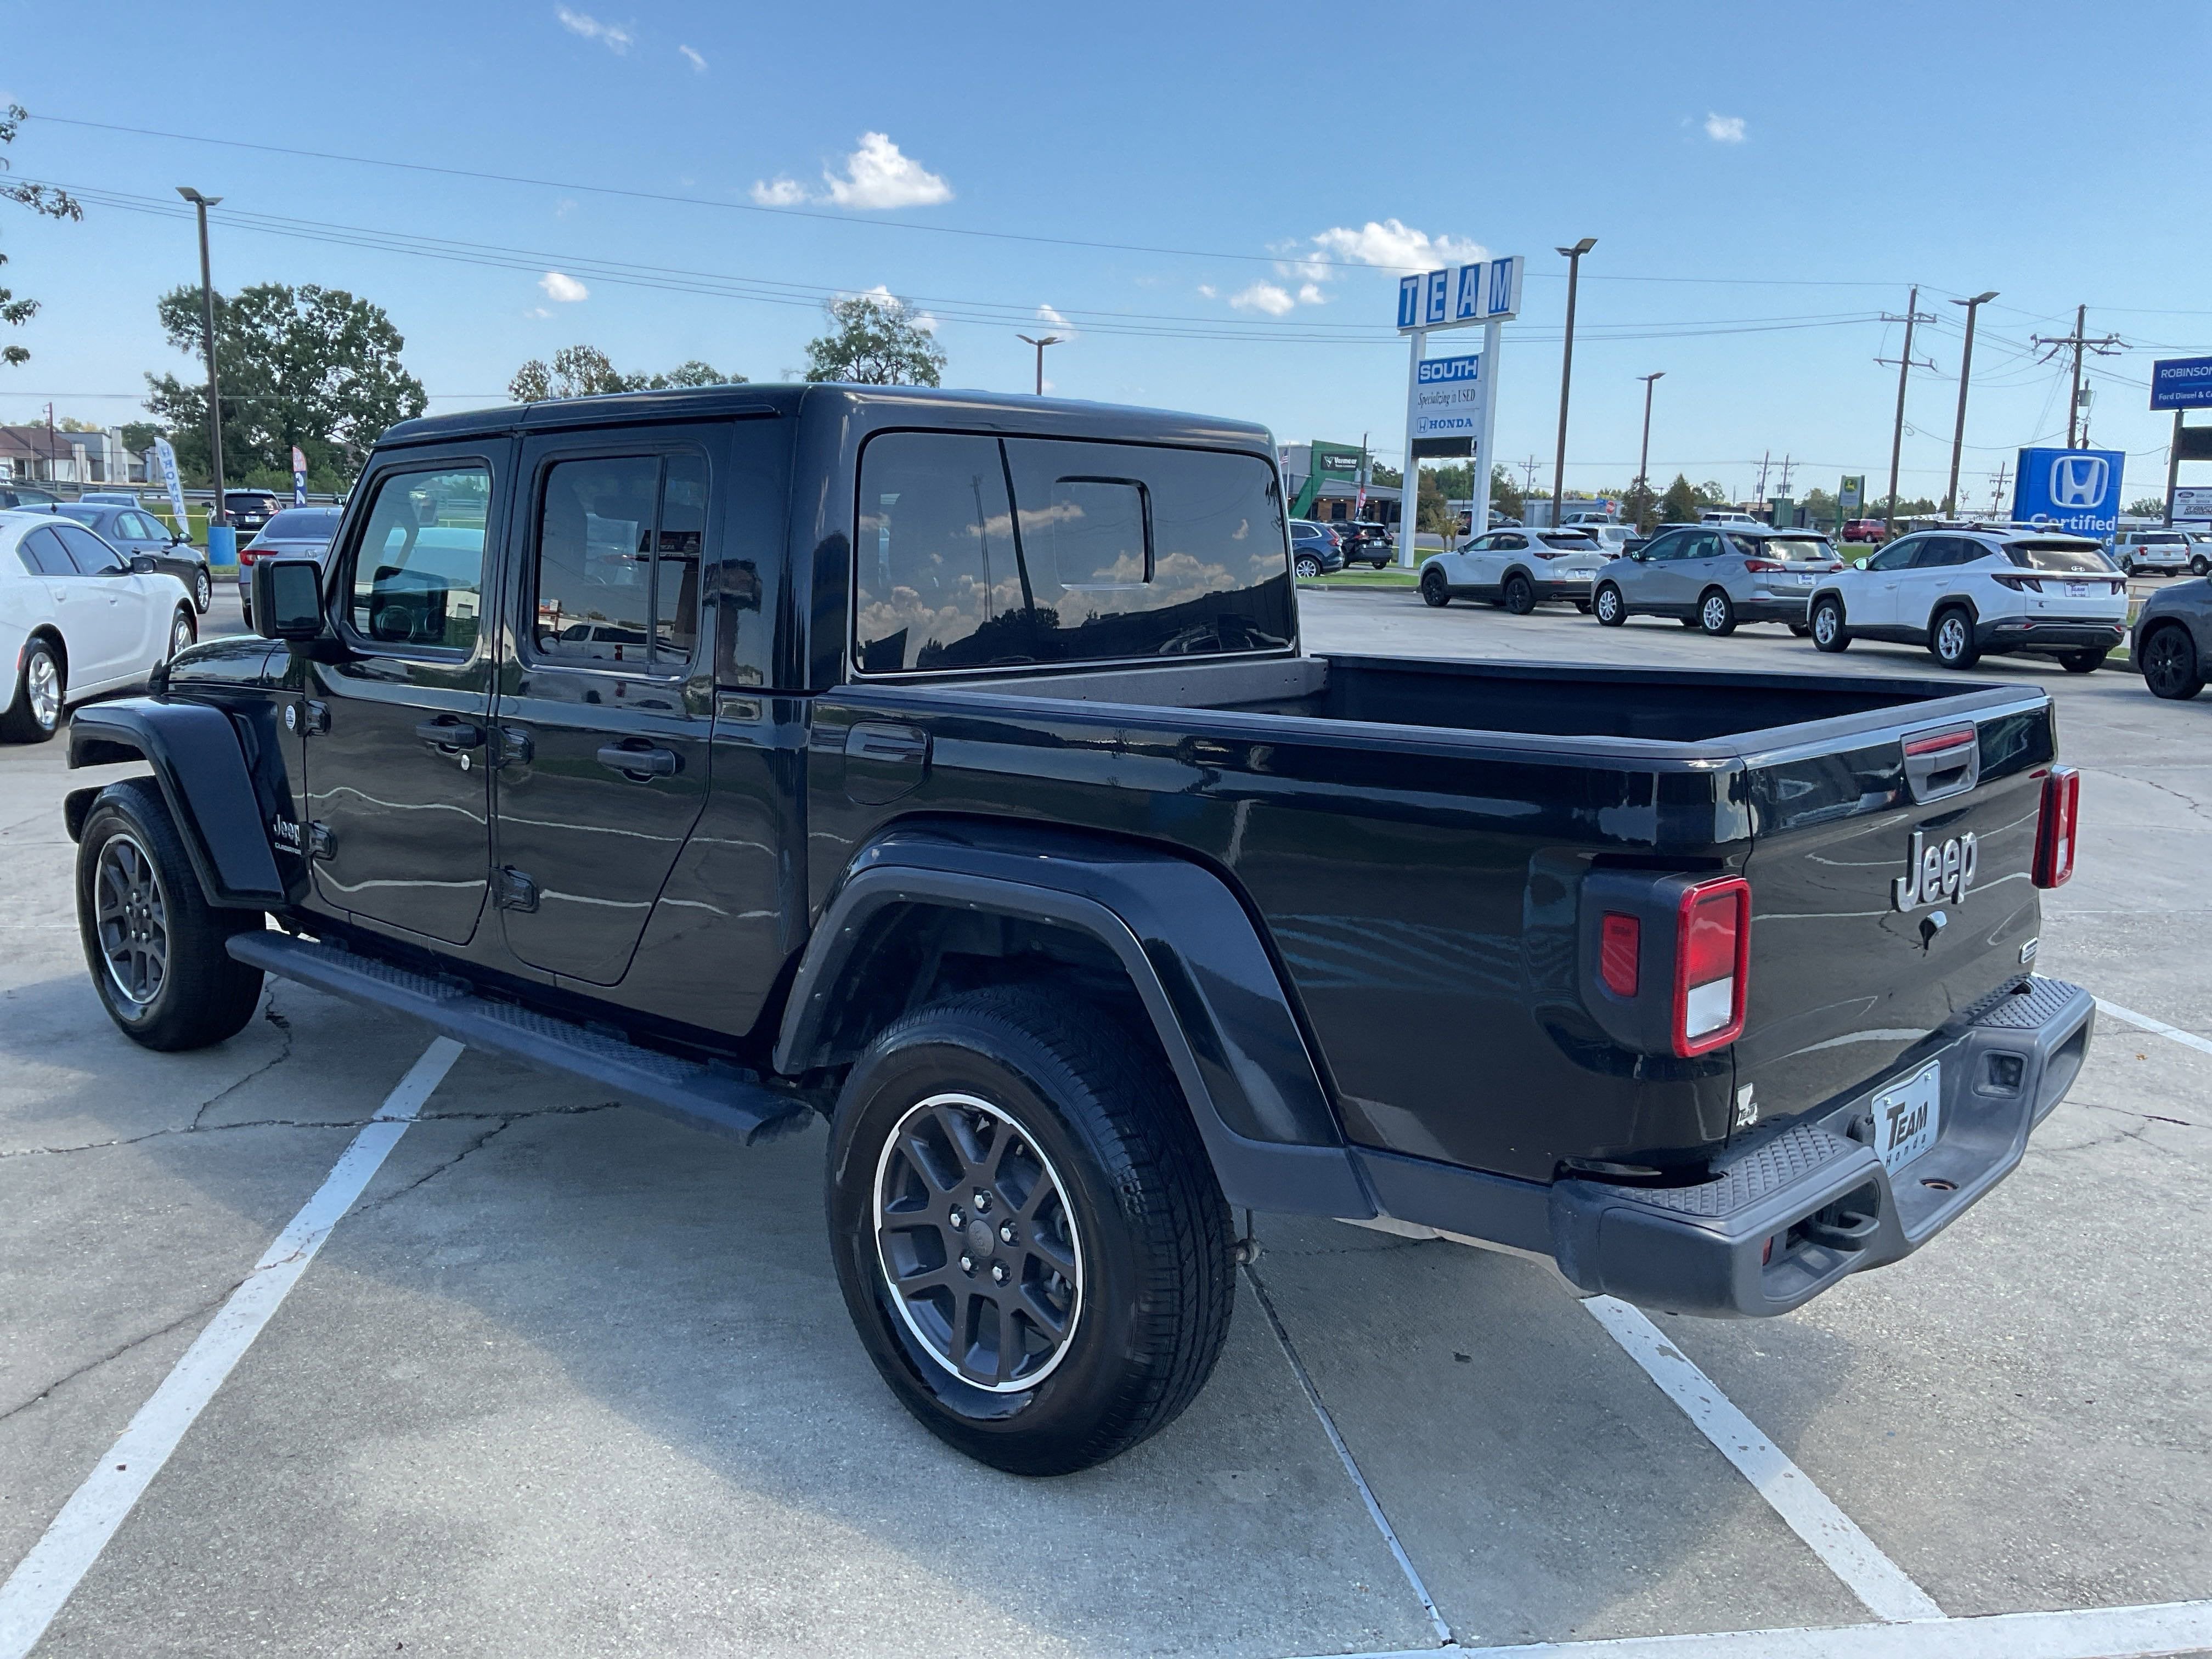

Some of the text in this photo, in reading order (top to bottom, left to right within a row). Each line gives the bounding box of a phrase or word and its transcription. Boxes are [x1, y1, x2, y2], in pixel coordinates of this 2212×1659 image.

[1402, 261, 1513, 324] TEAM
[1420, 360, 1477, 380] SOUTH
[1418, 391, 1450, 408] Specializing
[1458, 388, 1475, 402] USED
[1429, 418, 1473, 429] HONDA
[273, 814, 301, 845] Jeep
[1891, 831, 1977, 912] Jeep
[1886, 1101, 1928, 1152] TEAM
[1885, 1133, 1926, 1168] Honda
